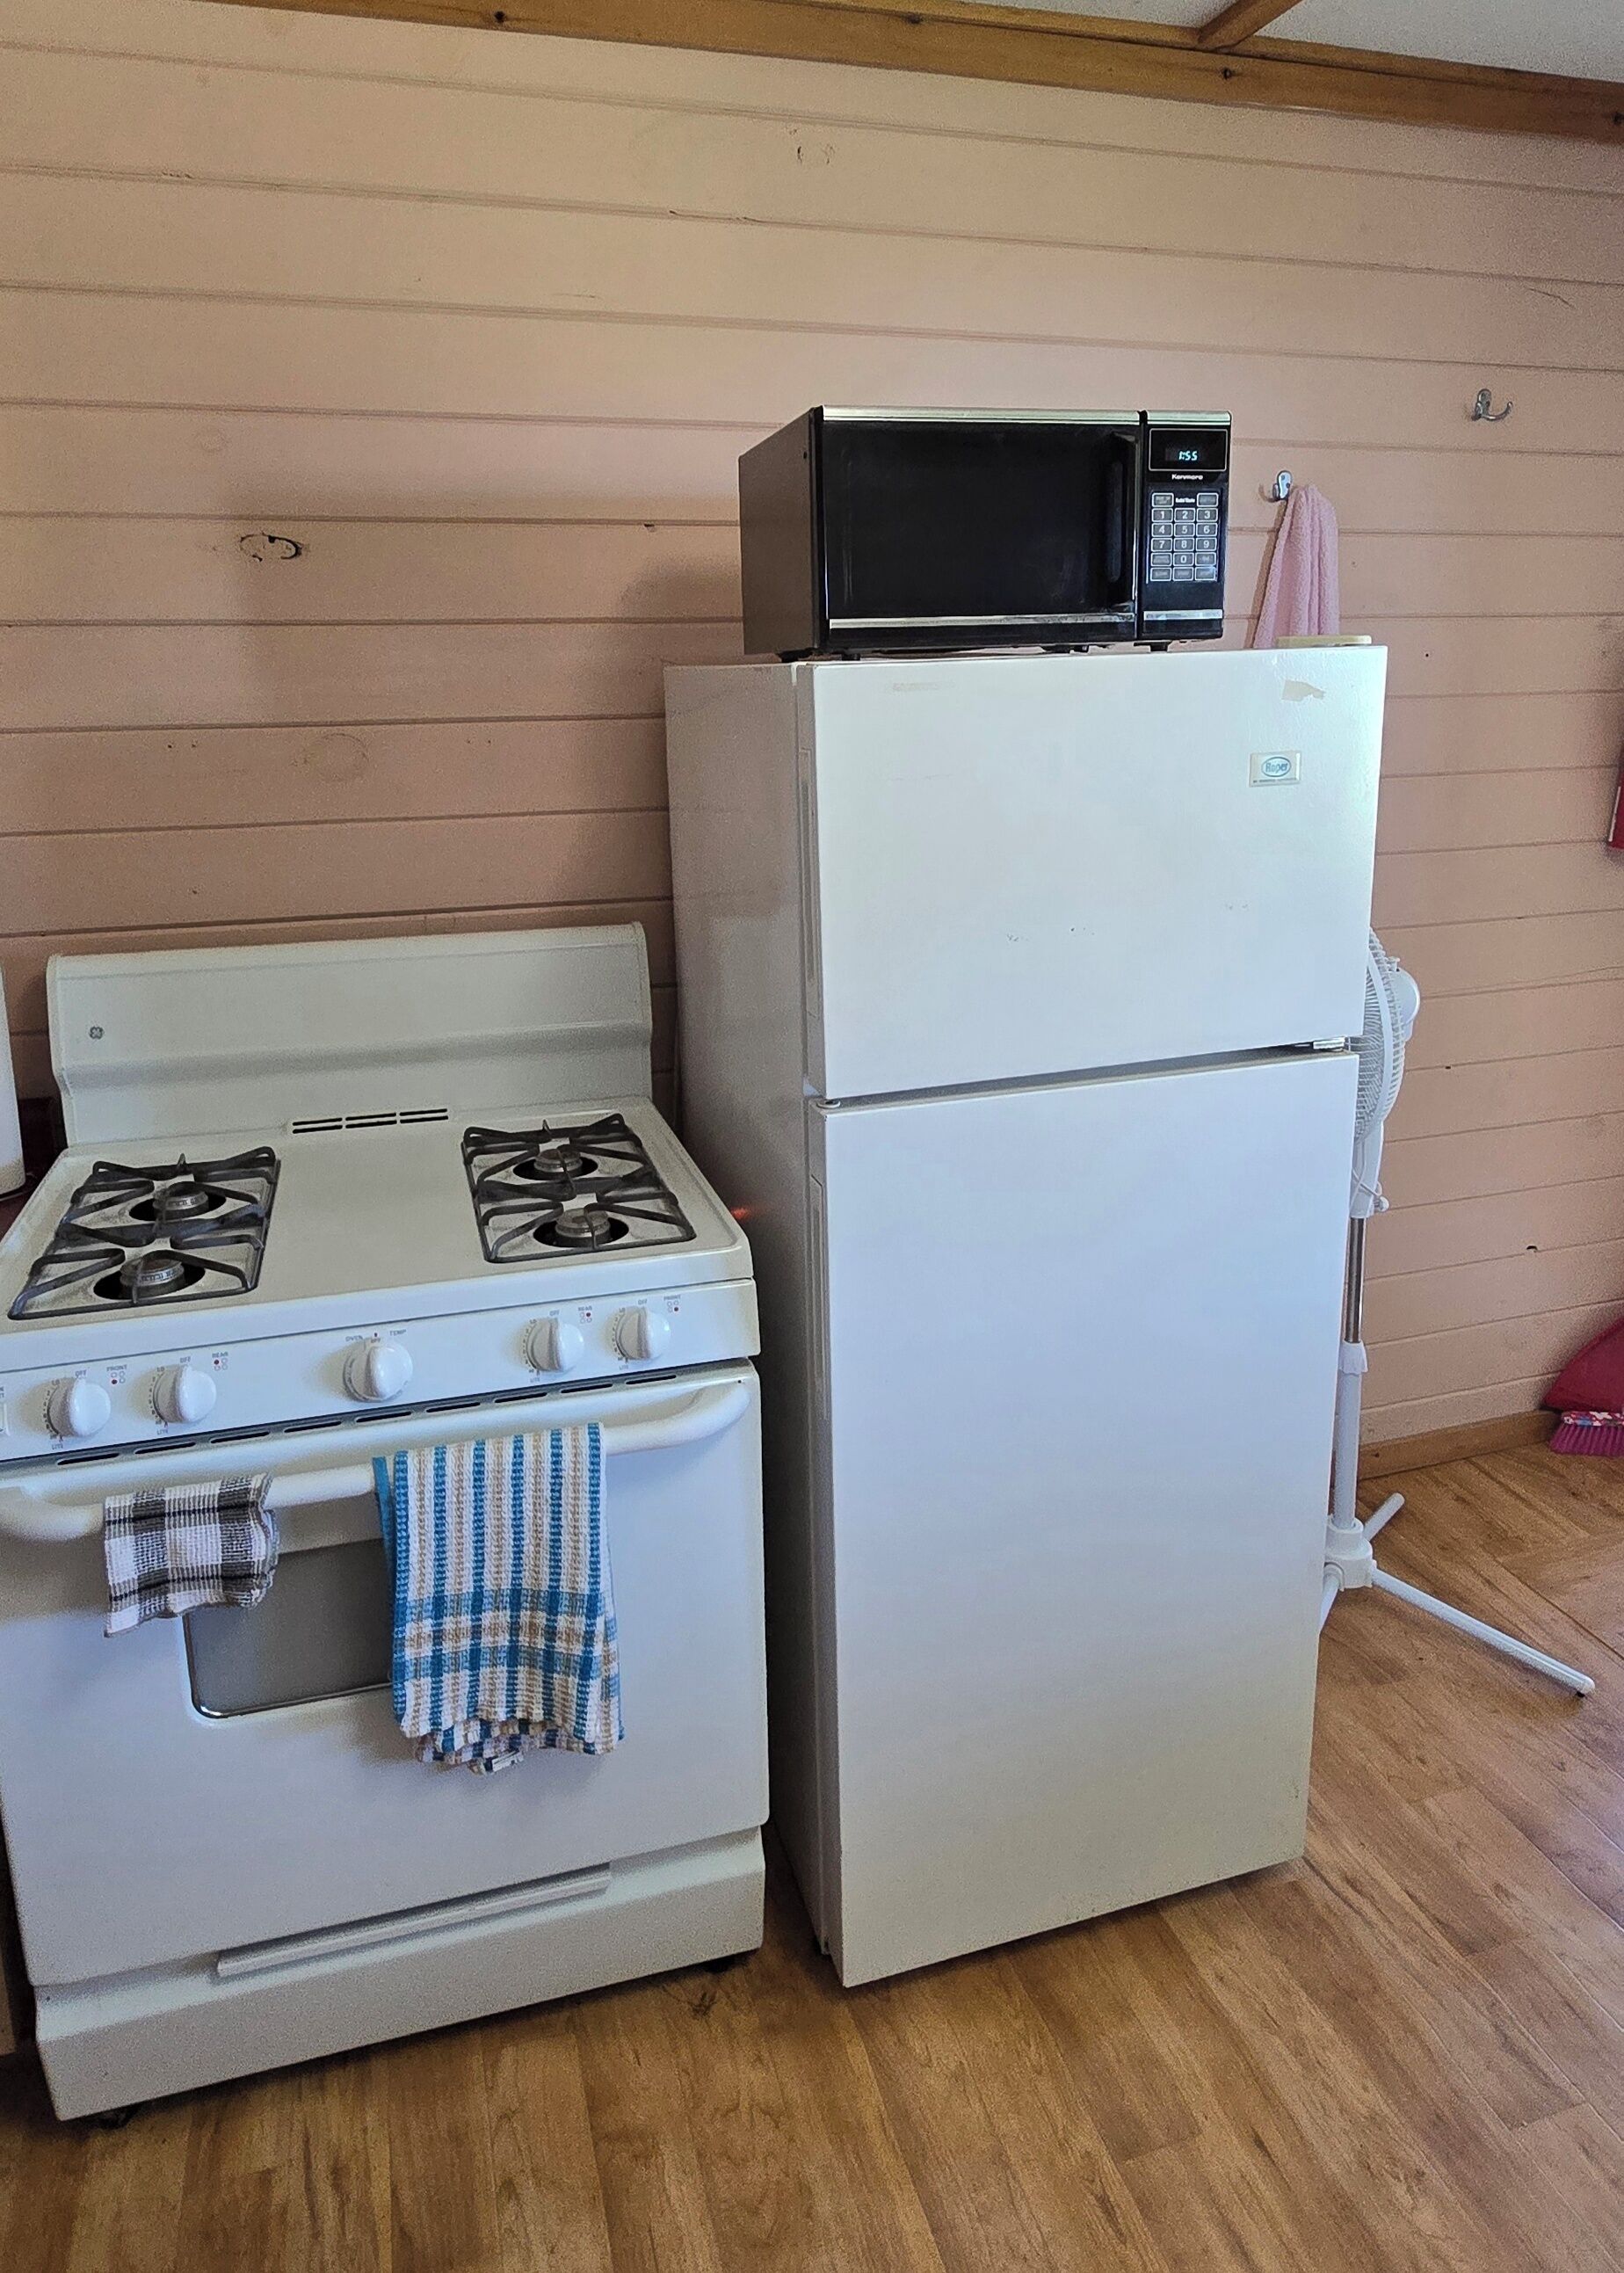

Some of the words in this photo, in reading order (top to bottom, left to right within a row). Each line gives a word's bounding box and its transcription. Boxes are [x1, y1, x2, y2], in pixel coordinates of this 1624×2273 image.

[1182, 511, 1189, 519] 2
[1204, 511, 1211, 519] 3
[1158, 525, 1165, 534] 4
[1181, 525, 1188, 534] 5
[1203, 525, 1210, 534] 6
[1159, 540, 1165, 549] 7
[1181, 540, 1187, 549] 8
[1203, 540, 1210, 549] 9
[1180, 555, 1187, 563] 0
